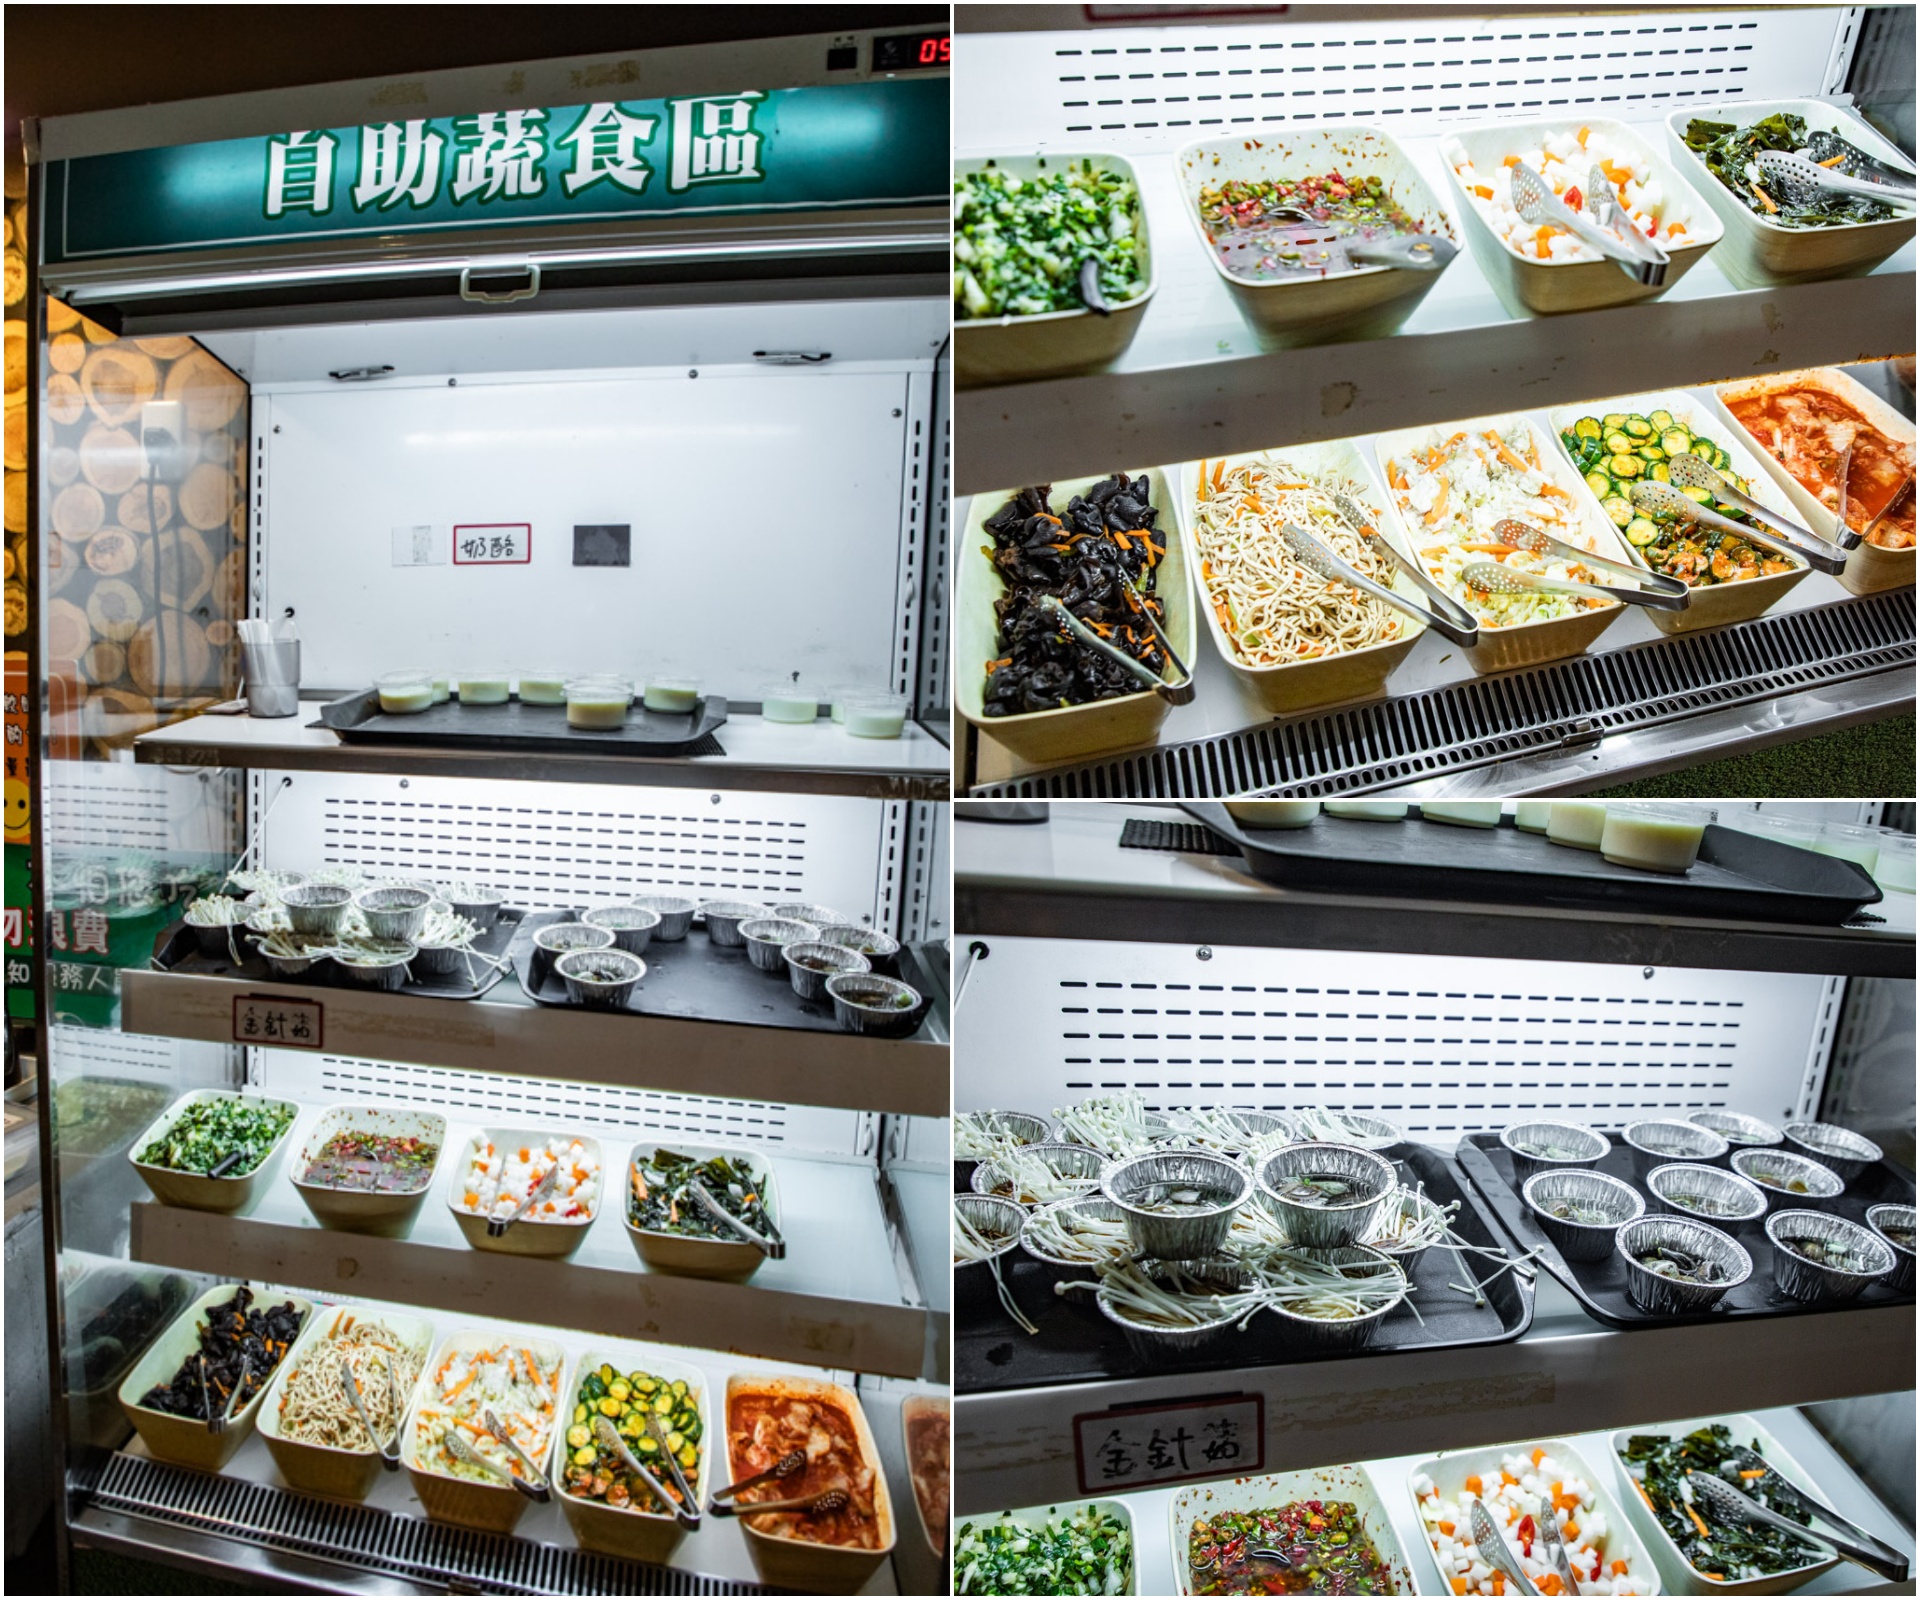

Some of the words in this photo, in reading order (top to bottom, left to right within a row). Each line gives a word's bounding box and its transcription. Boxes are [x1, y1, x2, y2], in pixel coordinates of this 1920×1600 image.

[265, 90, 765, 217] 自助蔬食區
[1095, 1417, 1241, 1480] 金針菇
